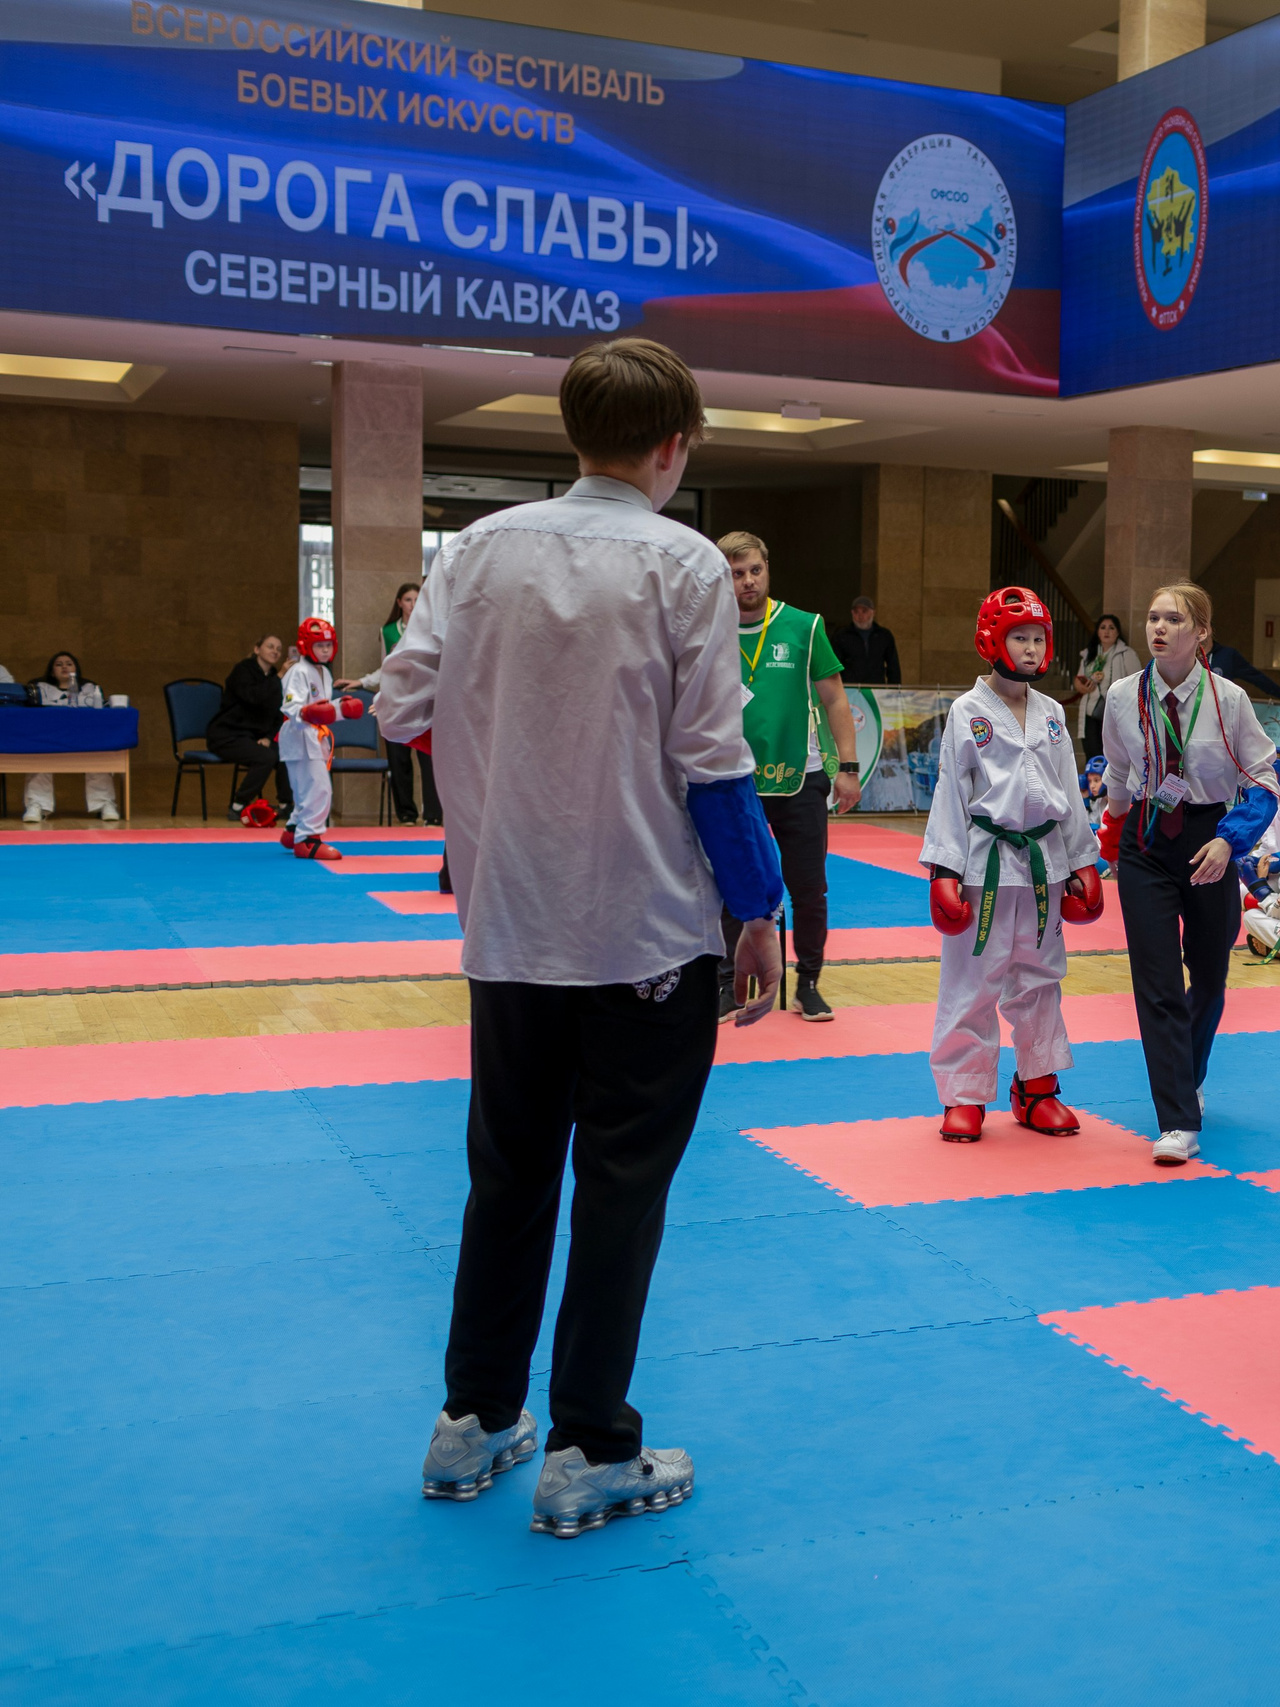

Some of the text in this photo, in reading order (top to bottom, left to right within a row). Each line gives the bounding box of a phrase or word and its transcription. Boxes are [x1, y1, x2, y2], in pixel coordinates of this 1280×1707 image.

[130, 0, 665, 106] ВСЕРОССИЙСКИЙ ФЕСТИВАЛЬ
[237, 69, 576, 145] БОЕВЫХ ИСКУССТВ
[889, 138, 953, 180] ФЕДЕРАЦИЯ
[63, 140, 719, 271] «ДОРОГА СЛАВЫ»
[930, 188, 970, 204] ОФСОО
[184, 249, 621, 332] СЕВЕРНЫЙ КАВКАЗ
[874, 192, 930, 335] ОБЩЕРОССИЙСКАЯ
[964, 291, 1005, 337] РОССИИ
[1159, 790, 1178, 804] СУДЬЯ
[979, 890, 994, 942] TAEKWON-DO
